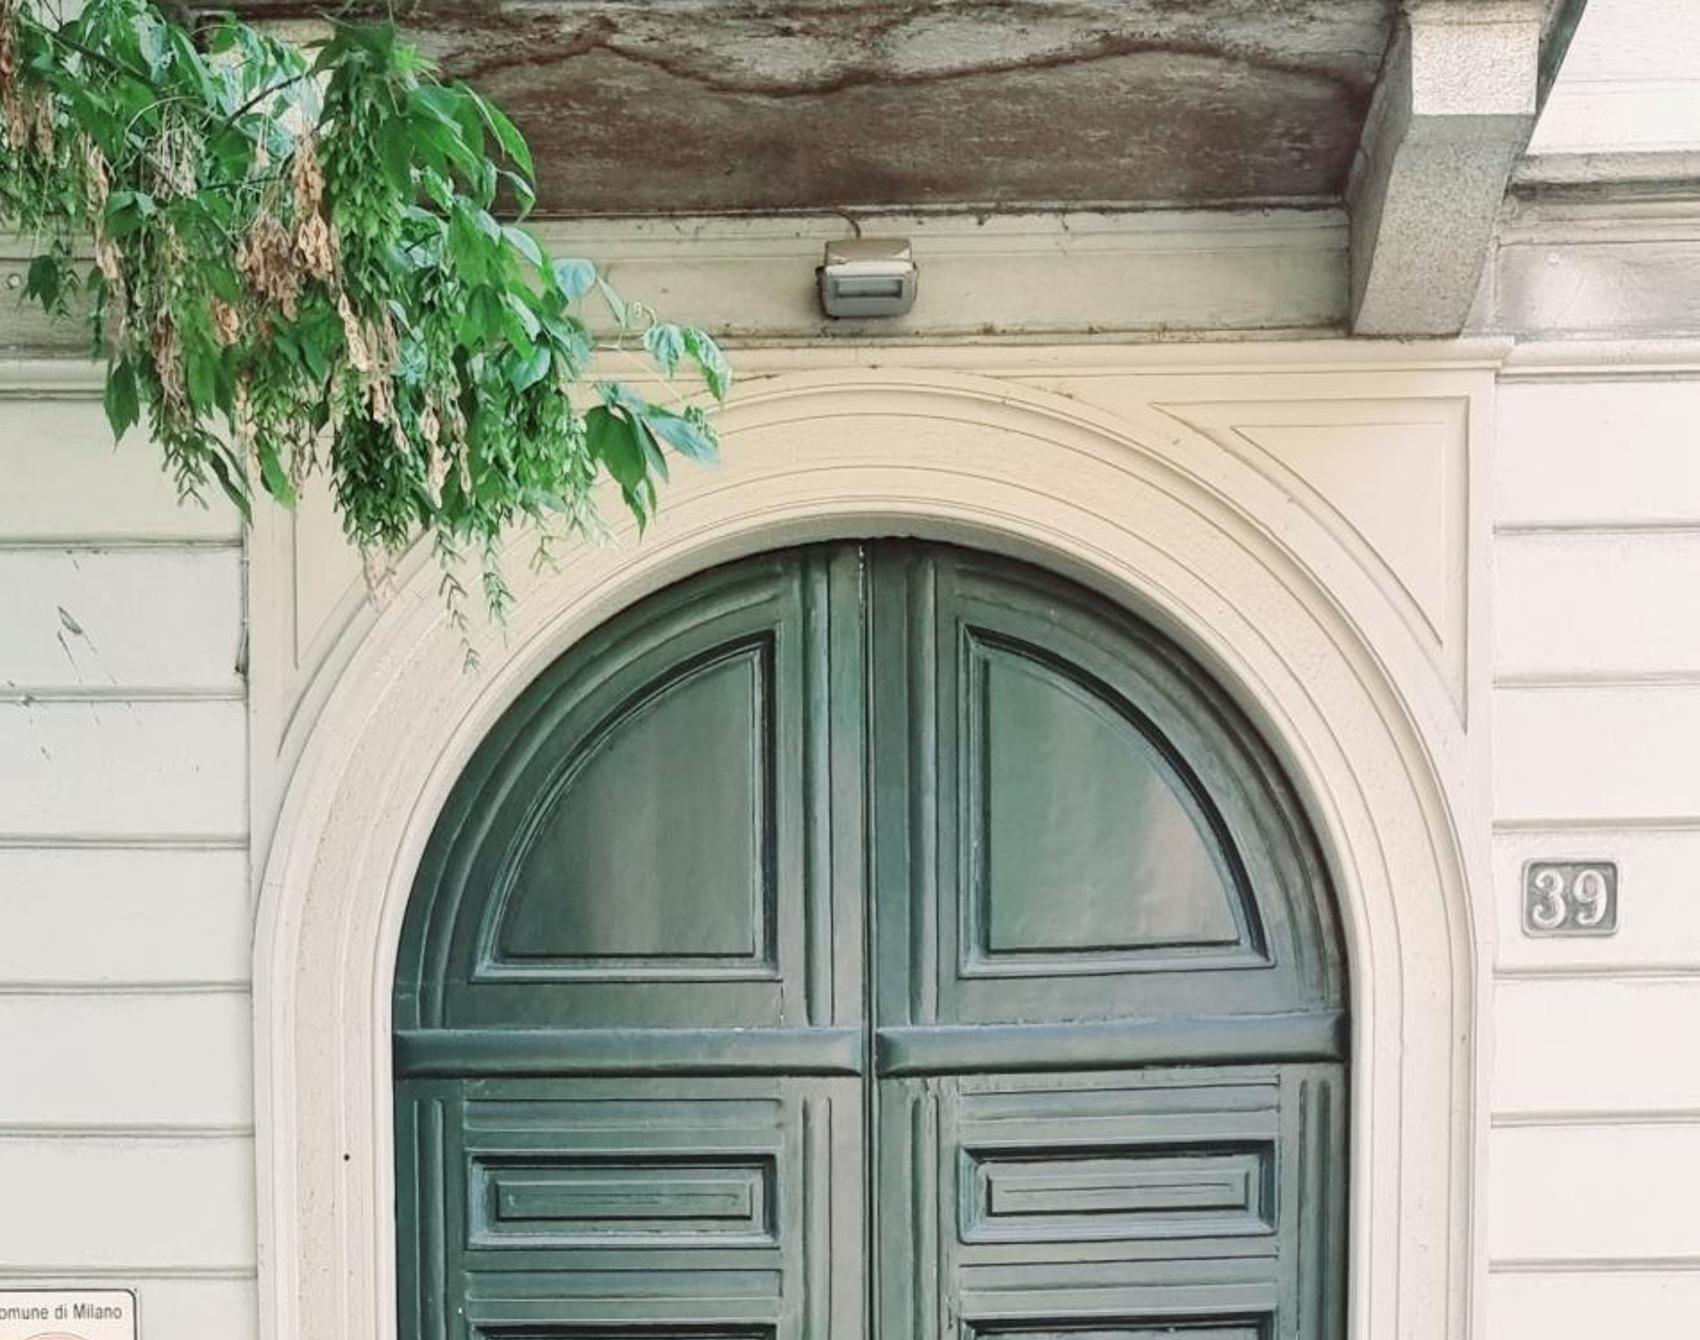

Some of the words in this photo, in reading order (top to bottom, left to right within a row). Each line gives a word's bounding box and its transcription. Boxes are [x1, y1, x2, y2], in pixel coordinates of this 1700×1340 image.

[1532, 868, 1608, 930] 39
[0, 1307, 49, 1320] omune
[55, 1303, 67, 1320] di
[73, 1303, 122, 1320] Milano
